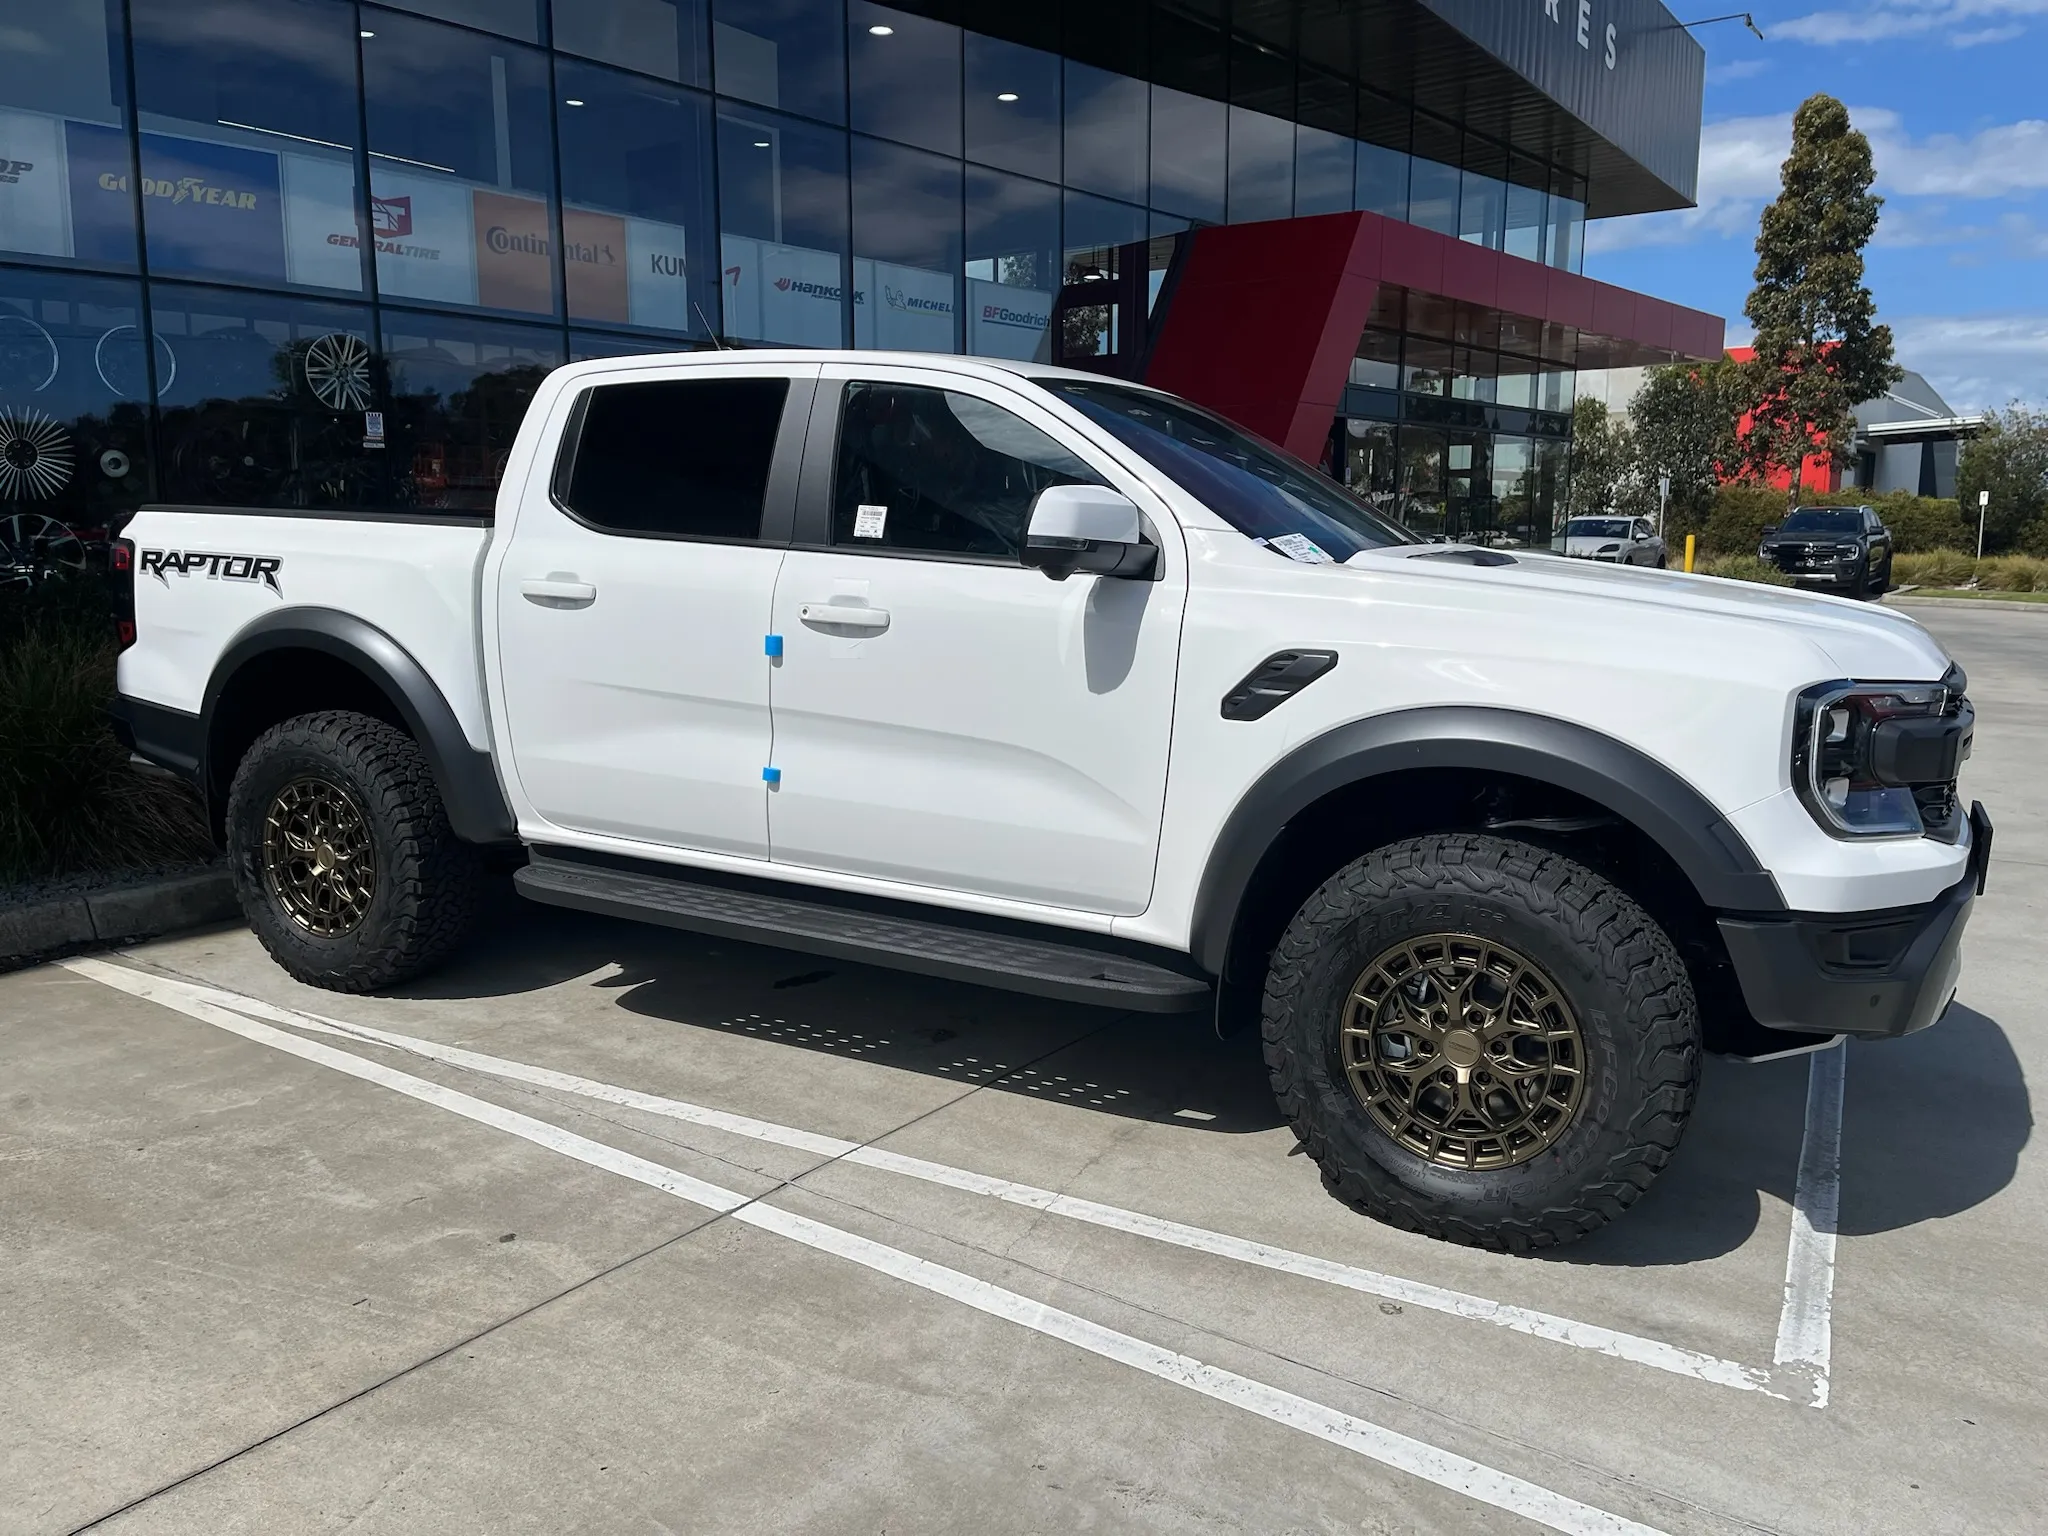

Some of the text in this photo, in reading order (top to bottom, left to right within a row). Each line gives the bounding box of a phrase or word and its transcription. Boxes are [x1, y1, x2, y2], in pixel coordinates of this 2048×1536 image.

[326, 234, 440, 260] GENRALTIRE
[486, 225, 598, 264] Continntal
[791, 281, 865, 301] Hankok
[982, 305, 1050, 327] BFGoodrich
[139, 548, 284, 600] RAPTOR
